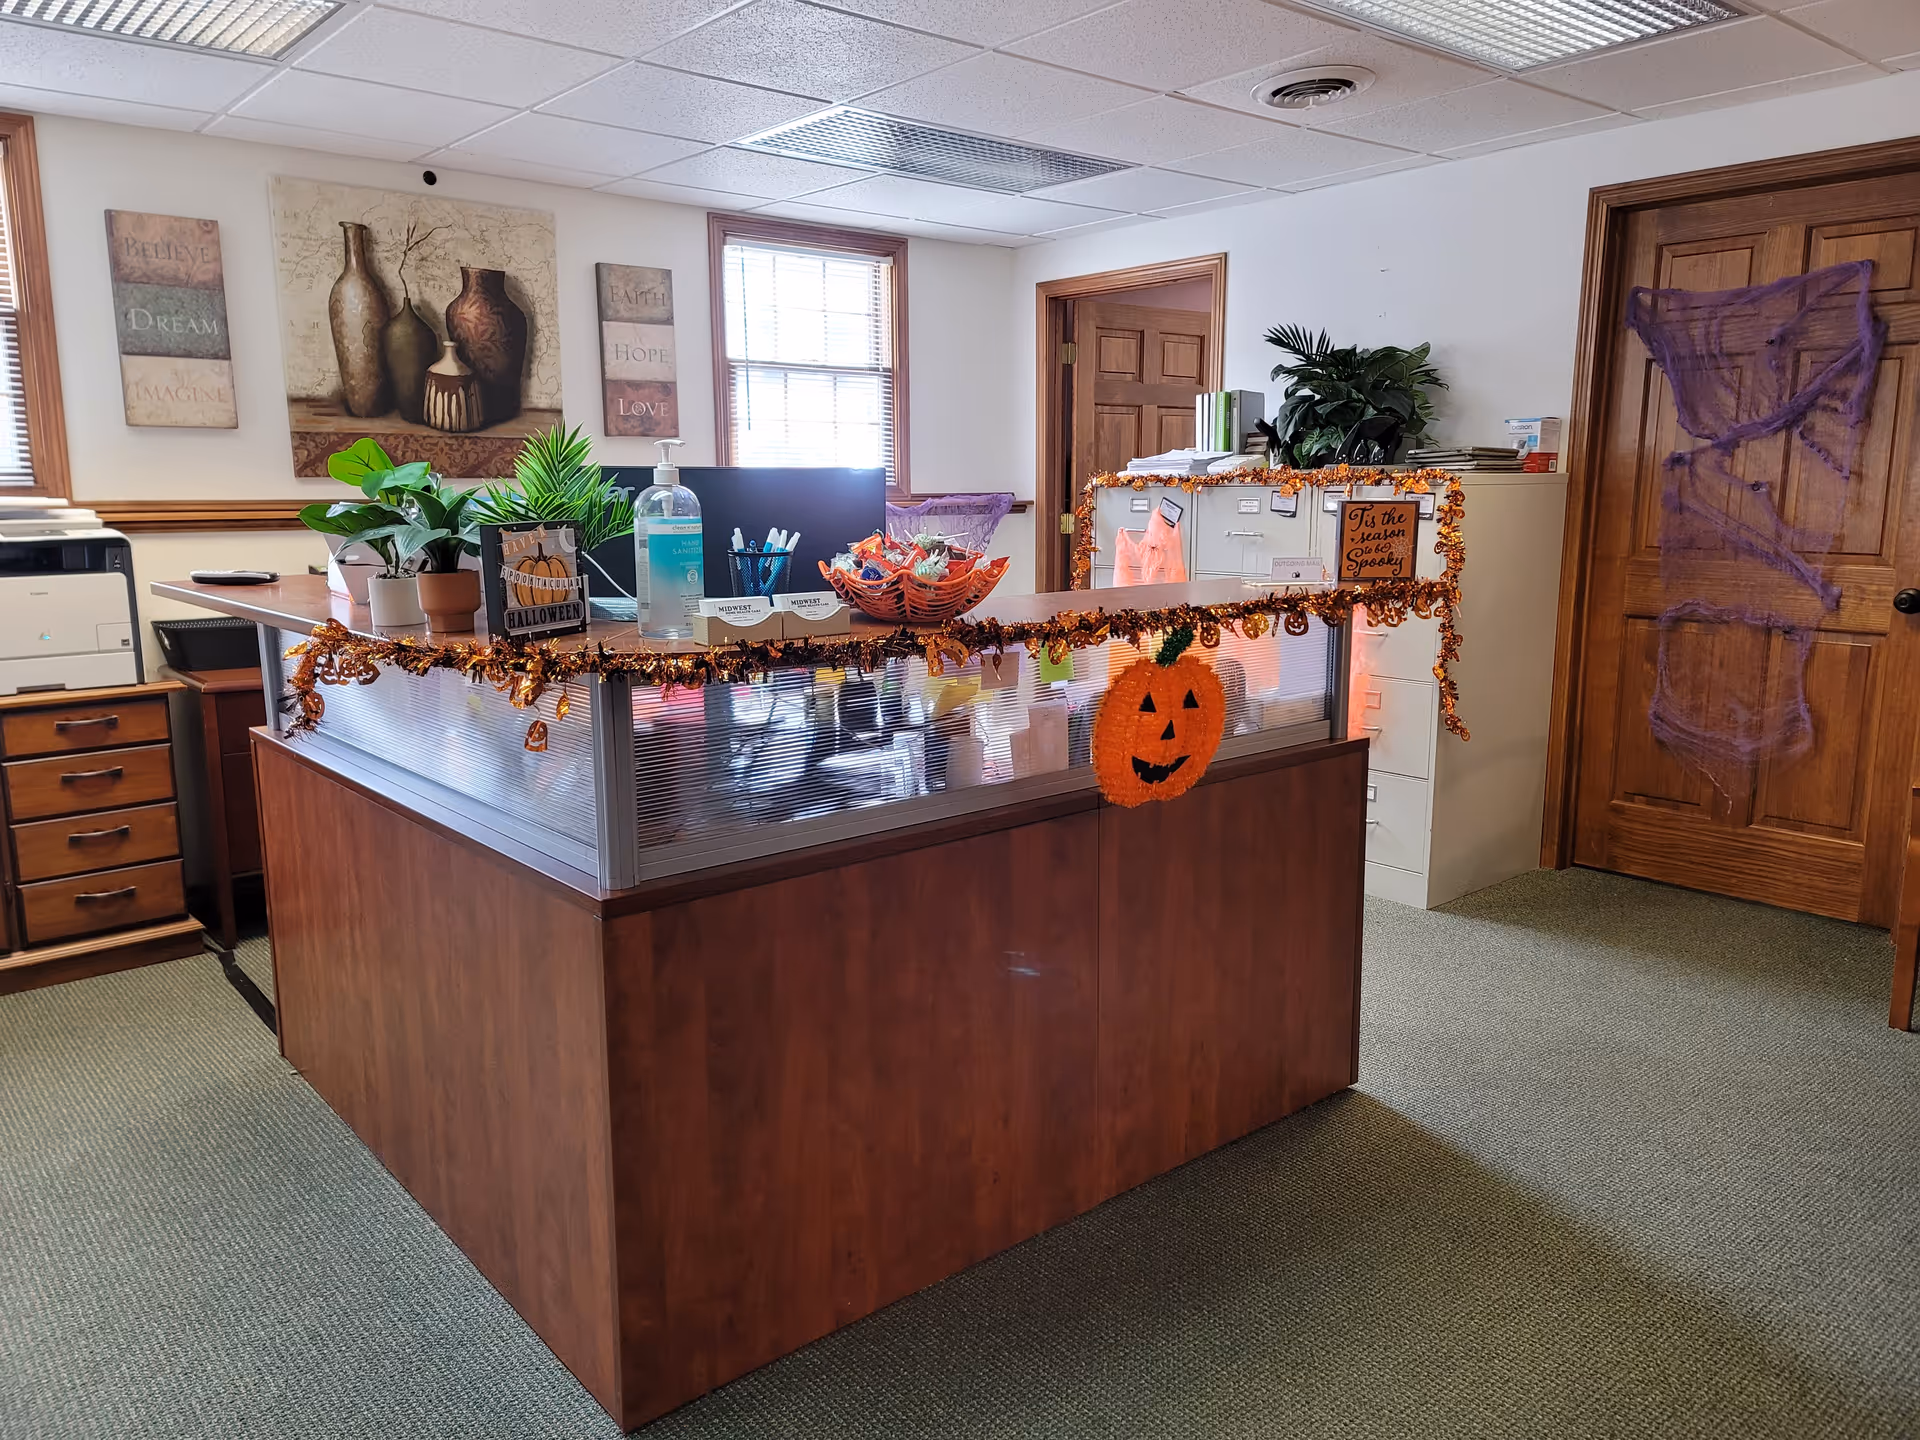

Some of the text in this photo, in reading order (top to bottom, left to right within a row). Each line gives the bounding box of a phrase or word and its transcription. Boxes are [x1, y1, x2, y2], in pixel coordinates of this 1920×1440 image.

[124, 237, 210, 264] BELIEVE
[609, 285, 667, 307] FAITH
[129, 308, 219, 335] DREAM
[614, 343, 669, 364] HOPE
[134, 381, 230, 404] IMAGINE
[618, 398, 669, 417] LOVE
[1381, 507, 1407, 526] the
[503, 526, 547, 556] HAVE A
[1354, 529, 1406, 545] season
[1364, 542, 1392, 554] to be
[1346, 548, 1404, 577] Spooky
[501, 568, 581, 588] SPOOKTACULAR
[718, 604, 752, 612] MIDWEST
[791, 598, 821, 606] MIDWEST
[507, 603, 581, 629] HALLOWEEN
